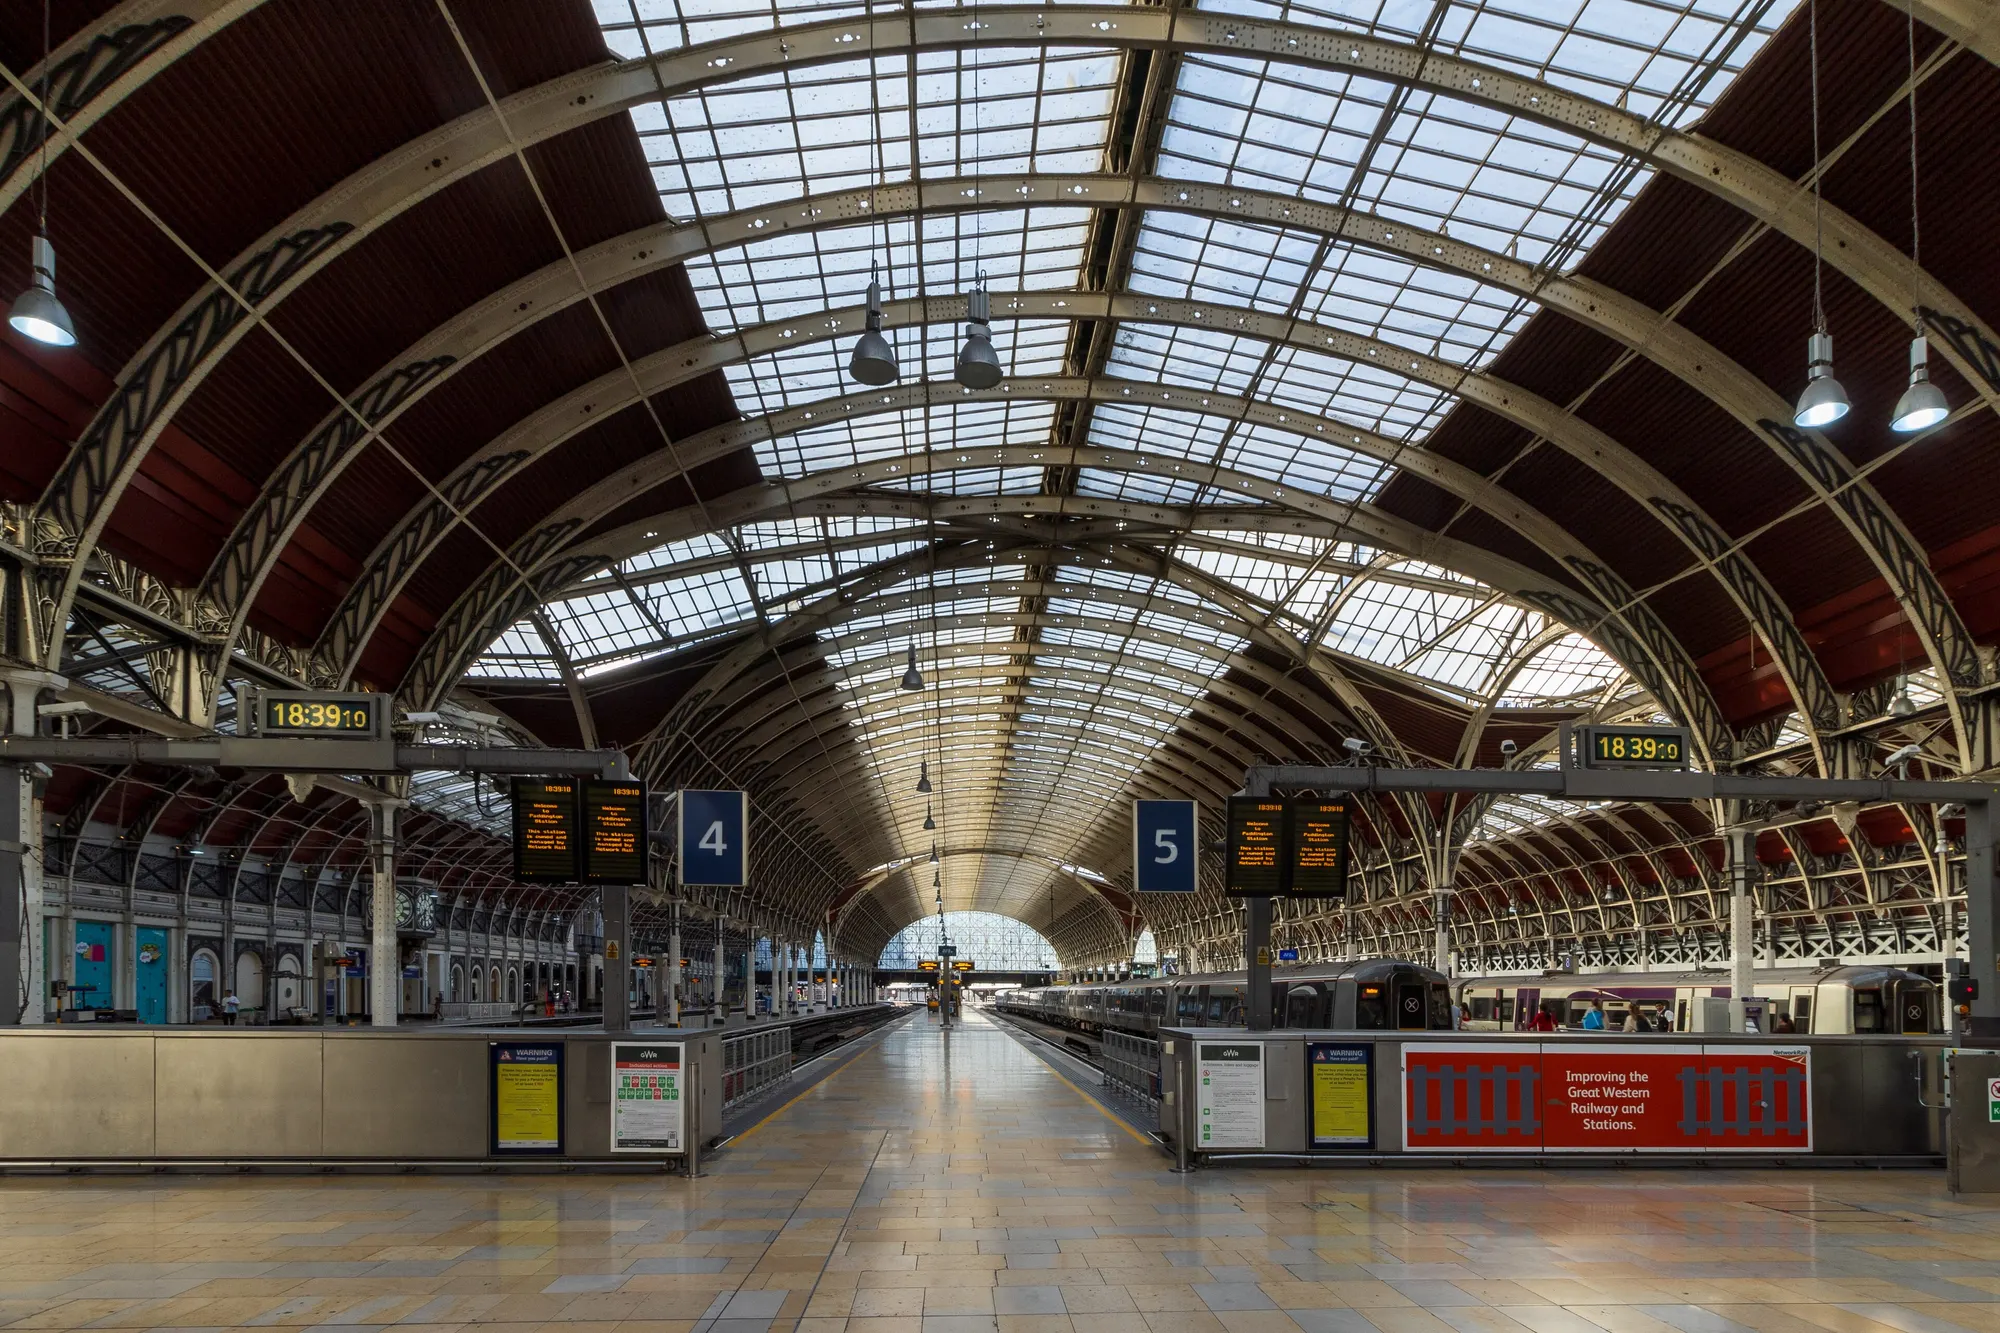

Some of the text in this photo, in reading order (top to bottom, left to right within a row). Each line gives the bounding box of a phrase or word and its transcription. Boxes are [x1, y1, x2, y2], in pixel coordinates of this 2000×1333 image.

[274, 703, 366, 728] 18:39 10
[698, 821, 727, 856] 4
[1154, 829, 1178, 864] 5
[1565, 957, 1570, 968] 8
[640, 1050, 657, 1058] GWR
[1223, 1049, 1239, 1057] GWR
[1566, 1070, 1649, 1085] Improving the
[1568, 1086, 1650, 1098] Great Western
[1571, 1102, 1644, 1116] Railway and
[1583, 1118, 1637, 1130] Stations.
